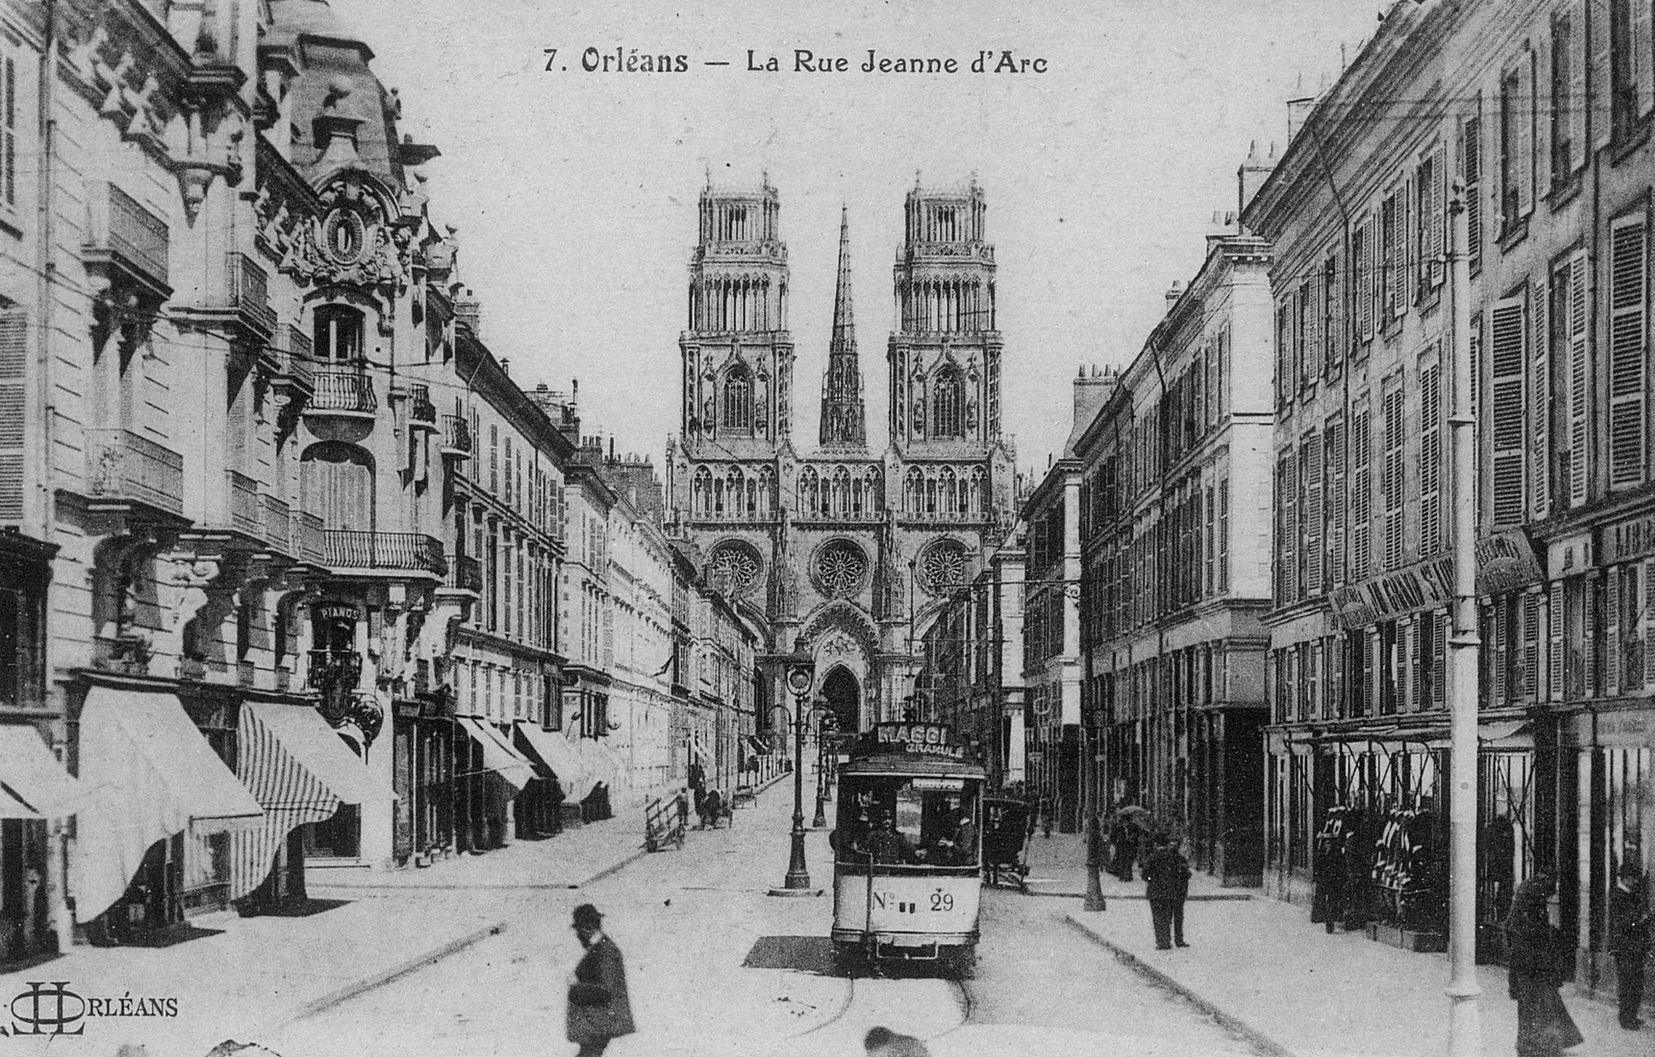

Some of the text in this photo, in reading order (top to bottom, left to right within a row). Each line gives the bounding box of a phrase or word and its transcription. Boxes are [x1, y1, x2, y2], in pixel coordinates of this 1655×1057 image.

[321, 606, 358, 620] PIANOS
[877, 725, 947, 744] MAGGI
[930, 893, 954, 912] 29
